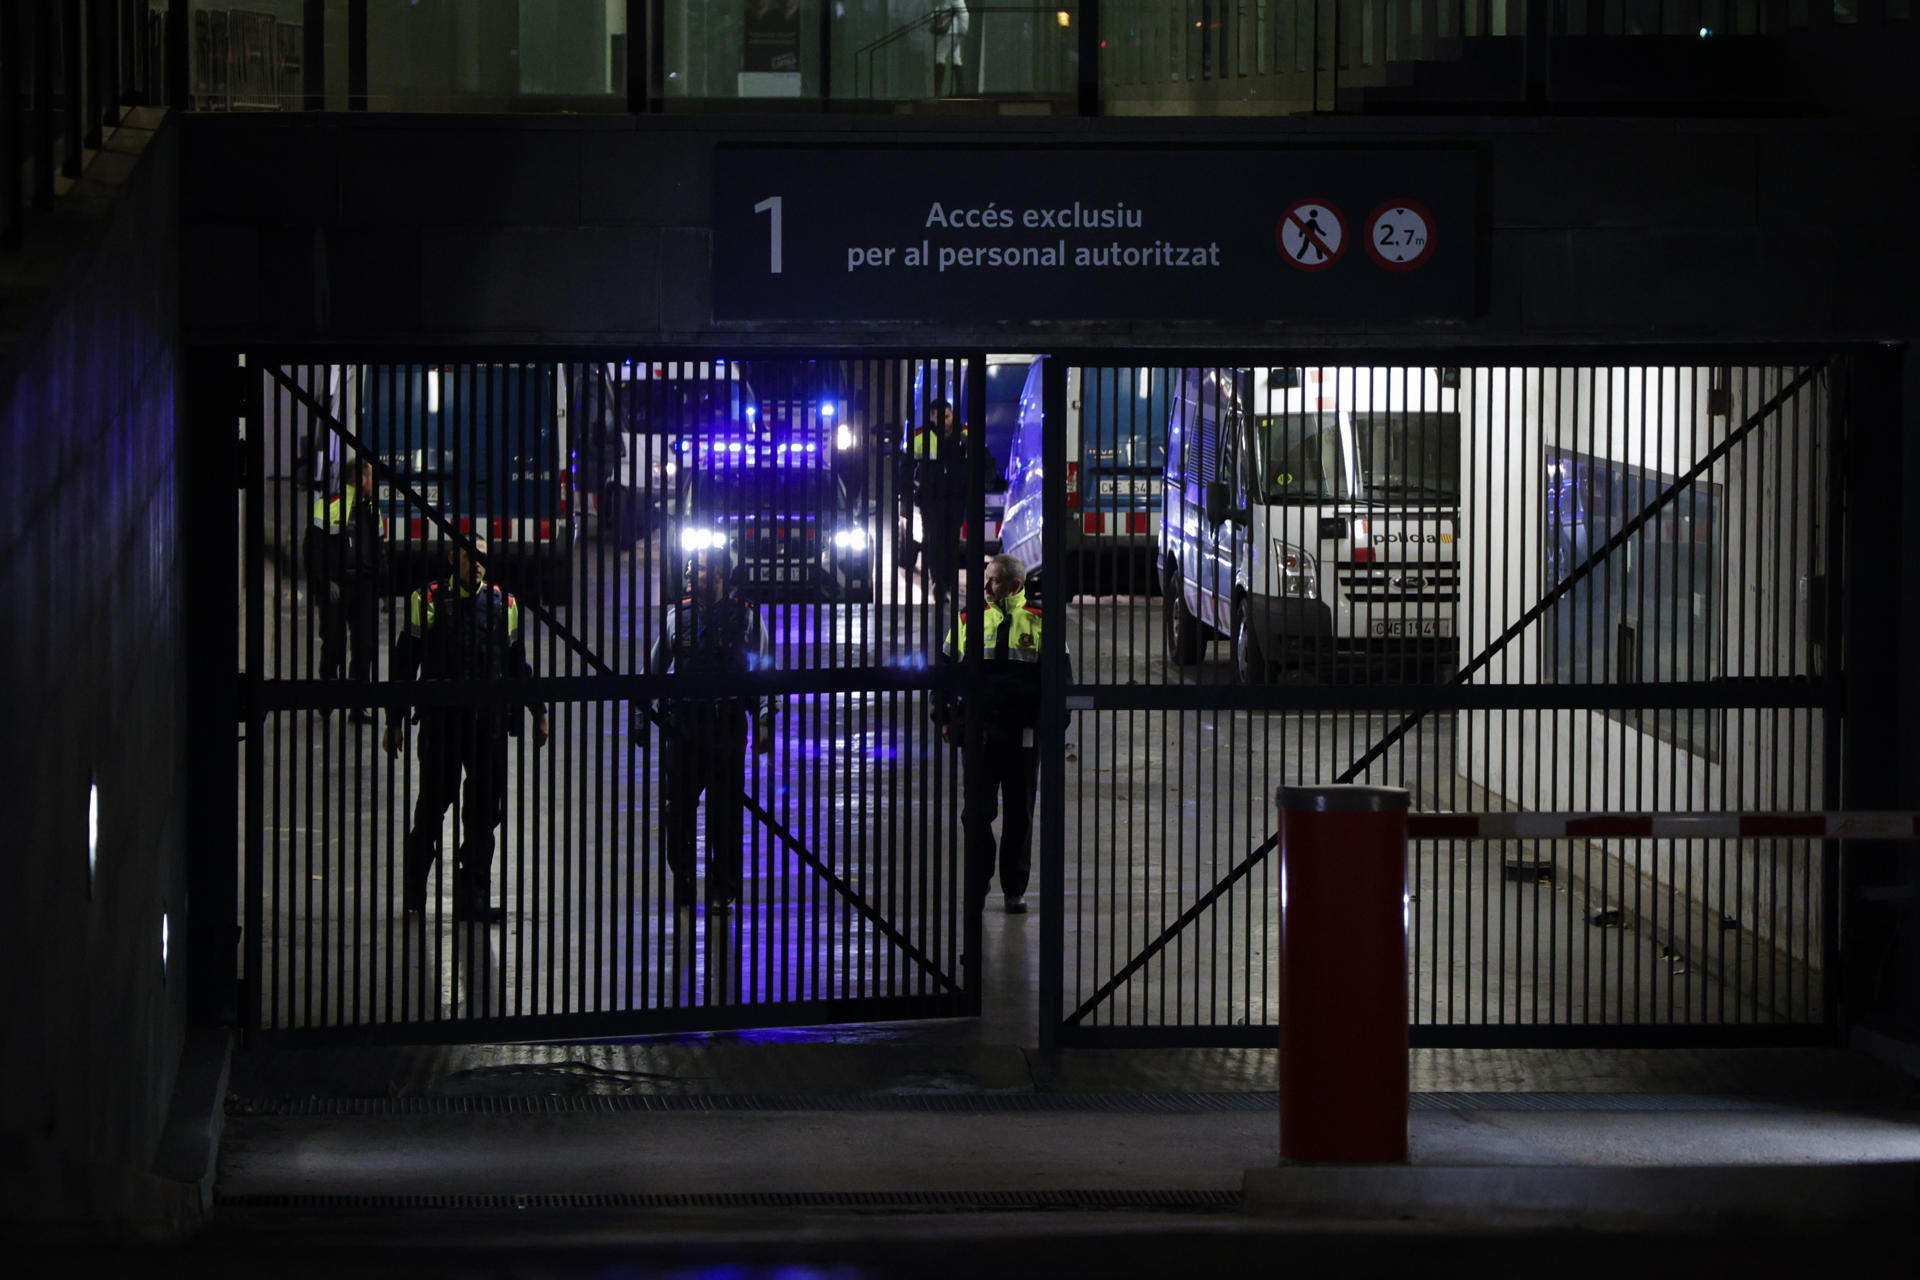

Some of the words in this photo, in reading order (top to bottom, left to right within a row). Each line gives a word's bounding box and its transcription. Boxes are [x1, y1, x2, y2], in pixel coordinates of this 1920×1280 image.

[925, 202, 1014, 229] Accés
[1023, 202, 1142, 229] exclusiu
[754, 196, 782, 273] 1
[848, 247, 896, 272] per
[904, 240, 929, 266] al
[939, 240, 1065, 272] personal
[1074, 240, 1219, 266] autoritzat
